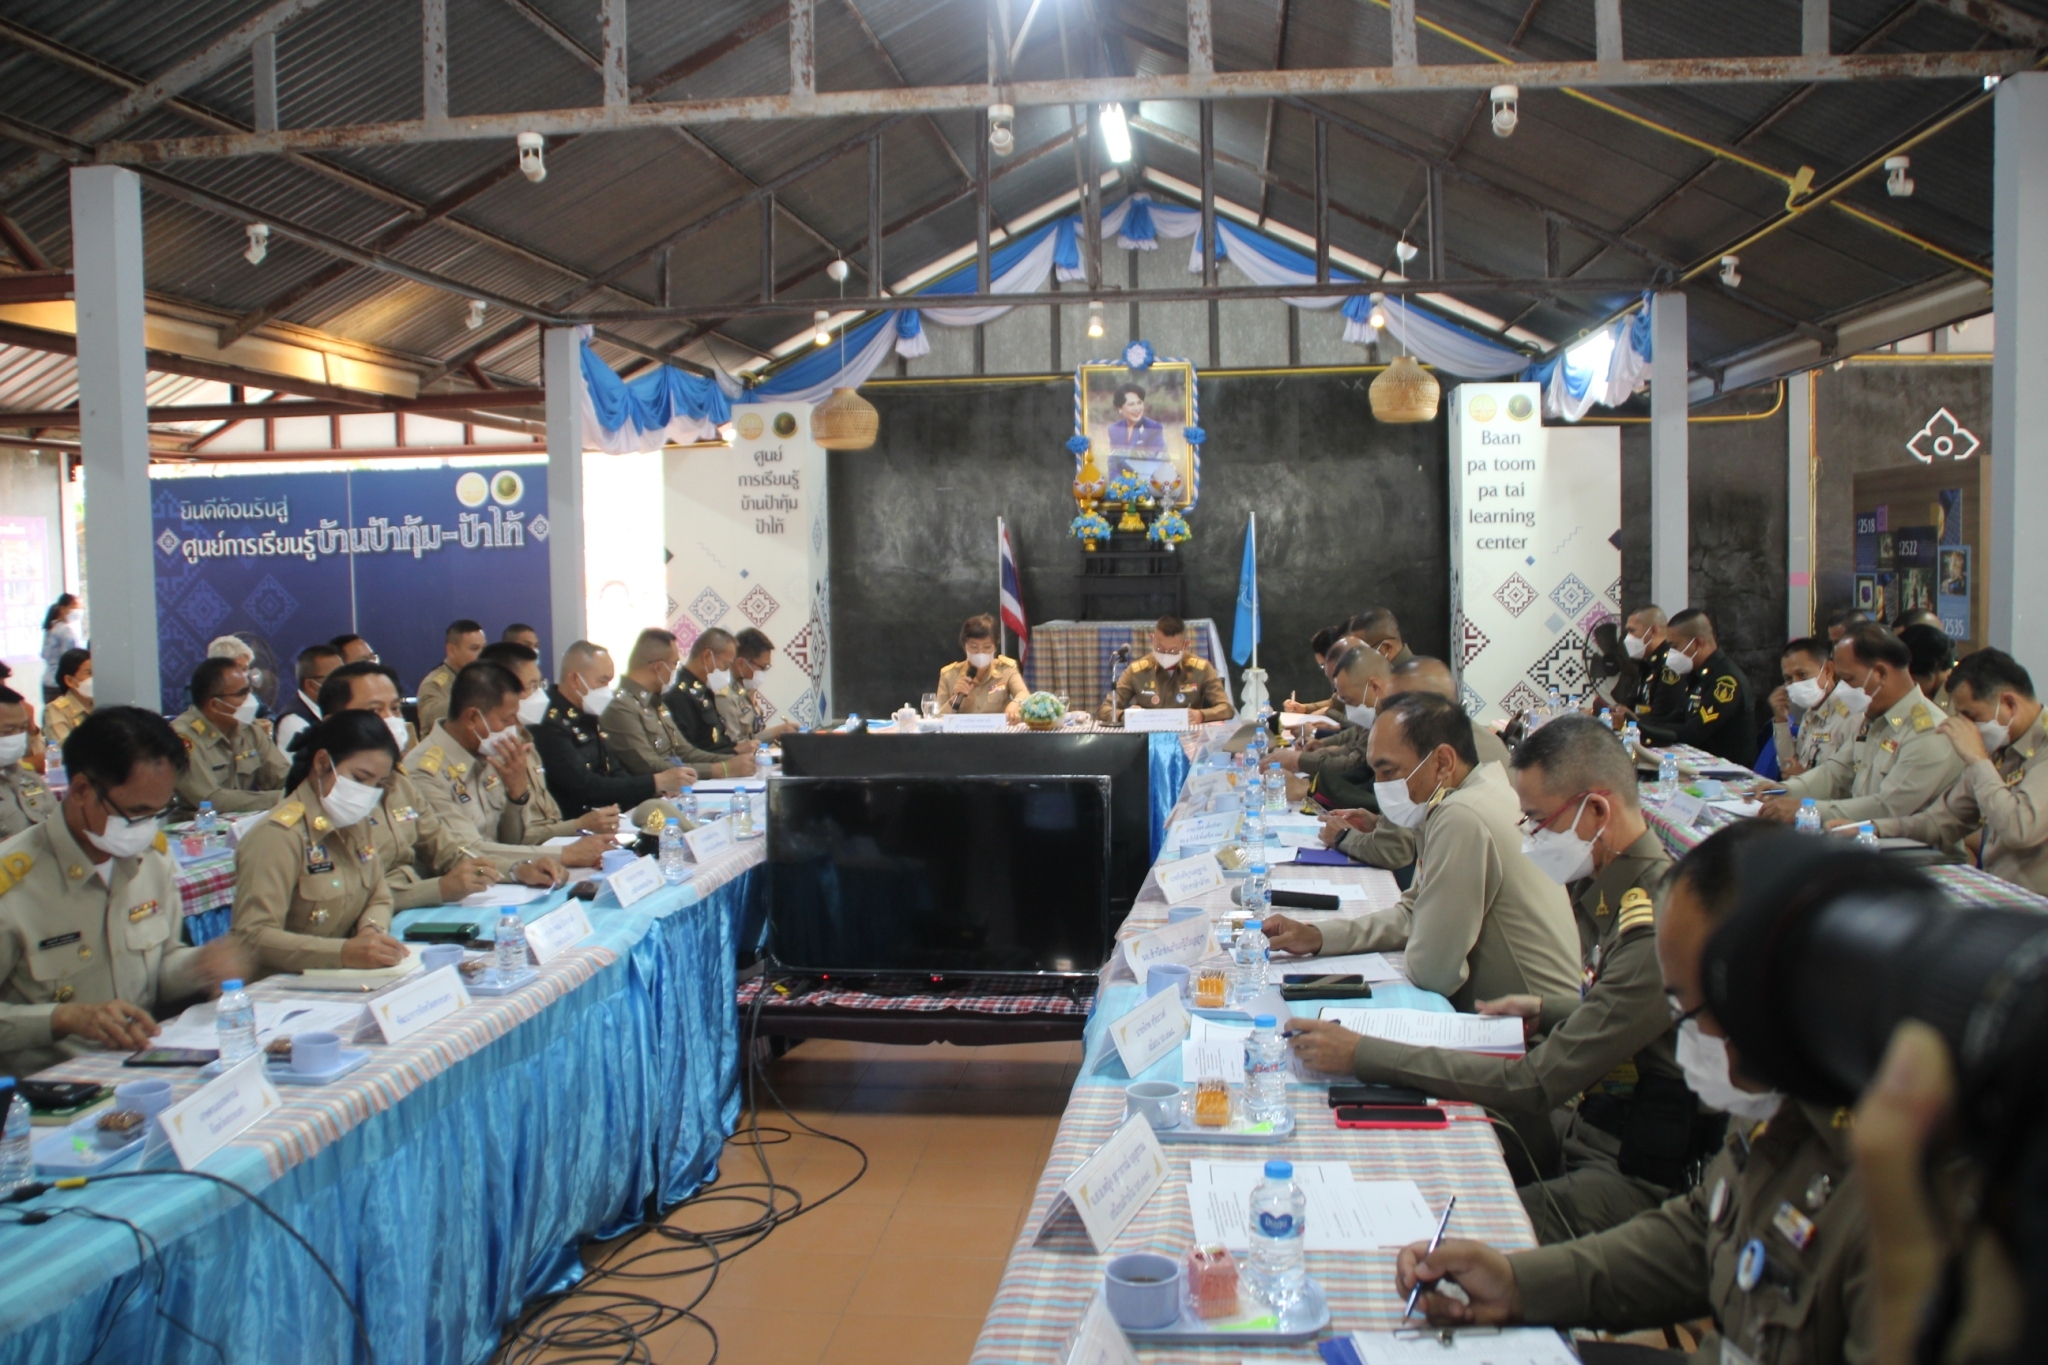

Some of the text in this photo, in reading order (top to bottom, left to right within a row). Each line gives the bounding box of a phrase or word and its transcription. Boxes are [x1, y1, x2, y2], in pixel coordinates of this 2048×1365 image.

[1481, 430, 1521, 445] Baan
[754, 445, 783, 467] ศูนย์
[1467, 457, 1536, 475] pa toom
[738, 469, 800, 490] การเรียนรู้
[1478, 482, 1525, 501] pa tai
[180, 494, 288, 523] ยินดีต้อนรับสู่
[1469, 508, 1536, 526] learning
[1860, 518, 1876, 534] 2518
[1476, 536, 1528, 550] center
[1901, 540, 1918, 556] 2522
[1944, 618, 1964, 637] 2535
